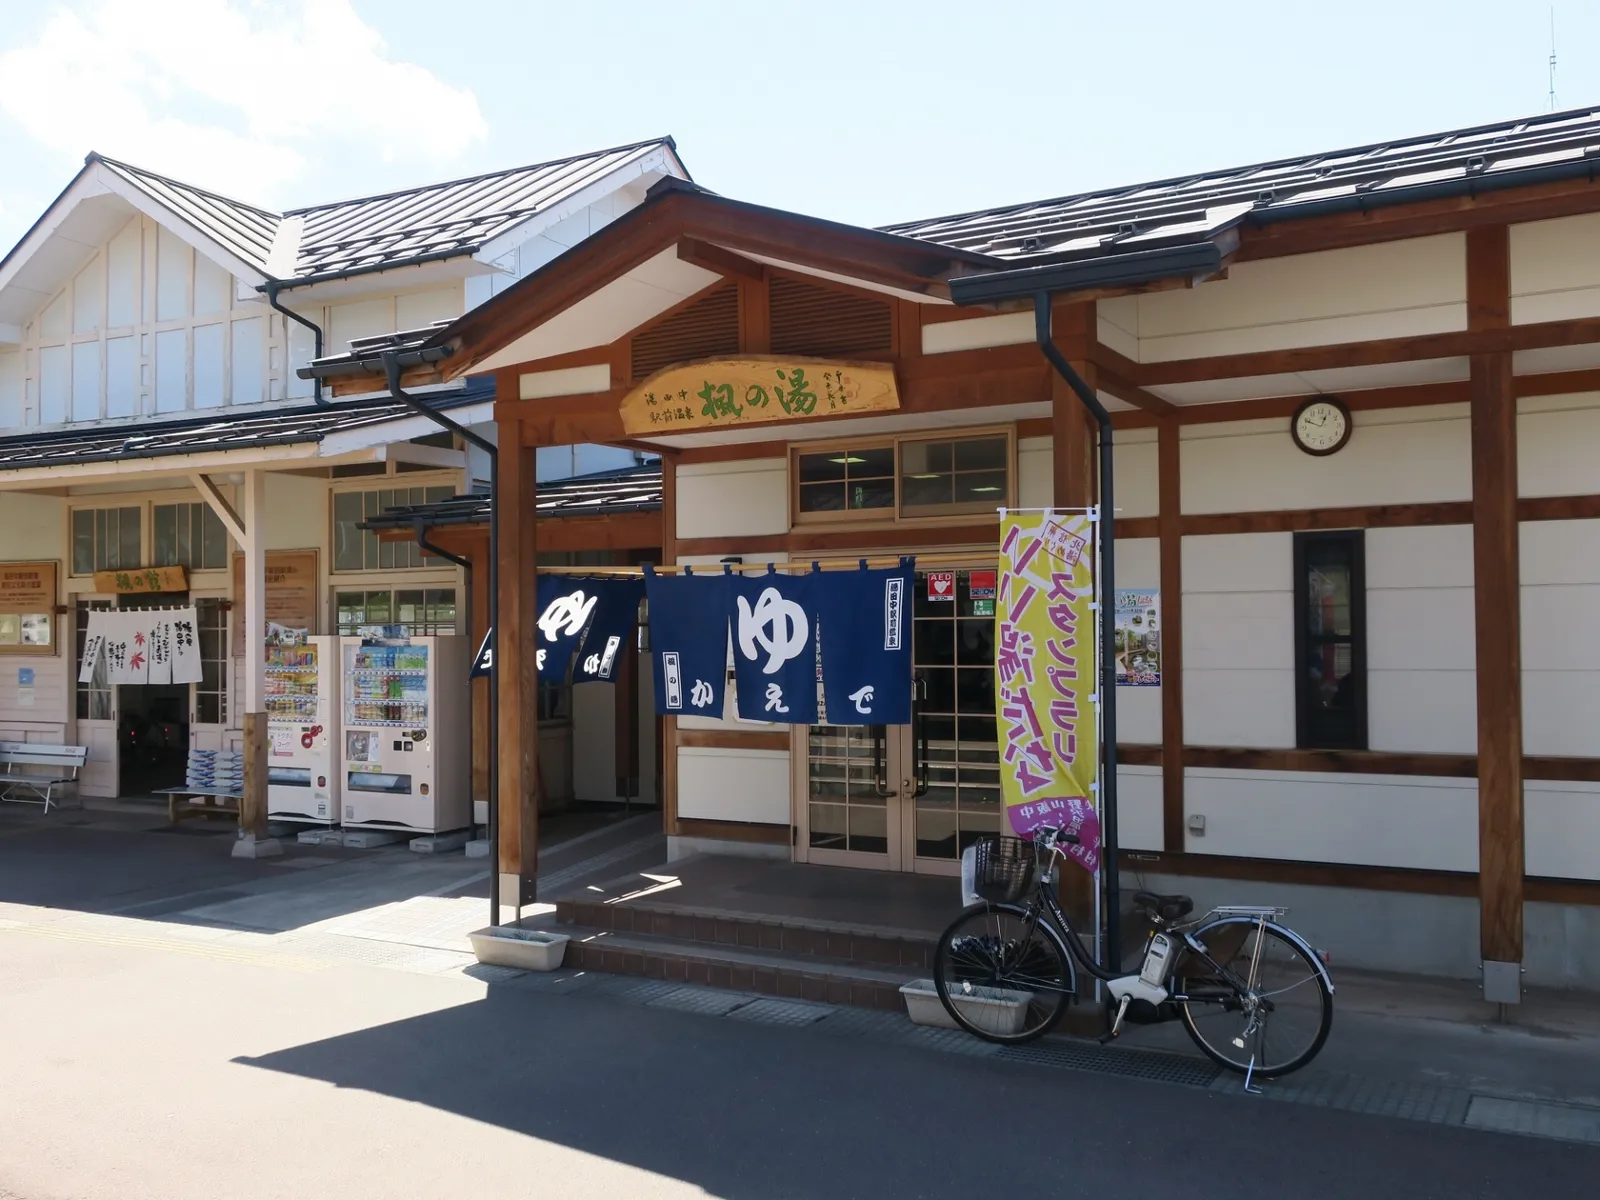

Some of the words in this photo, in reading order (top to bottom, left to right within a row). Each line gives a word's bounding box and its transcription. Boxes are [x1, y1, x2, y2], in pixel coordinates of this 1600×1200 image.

[698, 368, 817, 419] 楓の湯
[737, 587, 809, 674] ゆ
